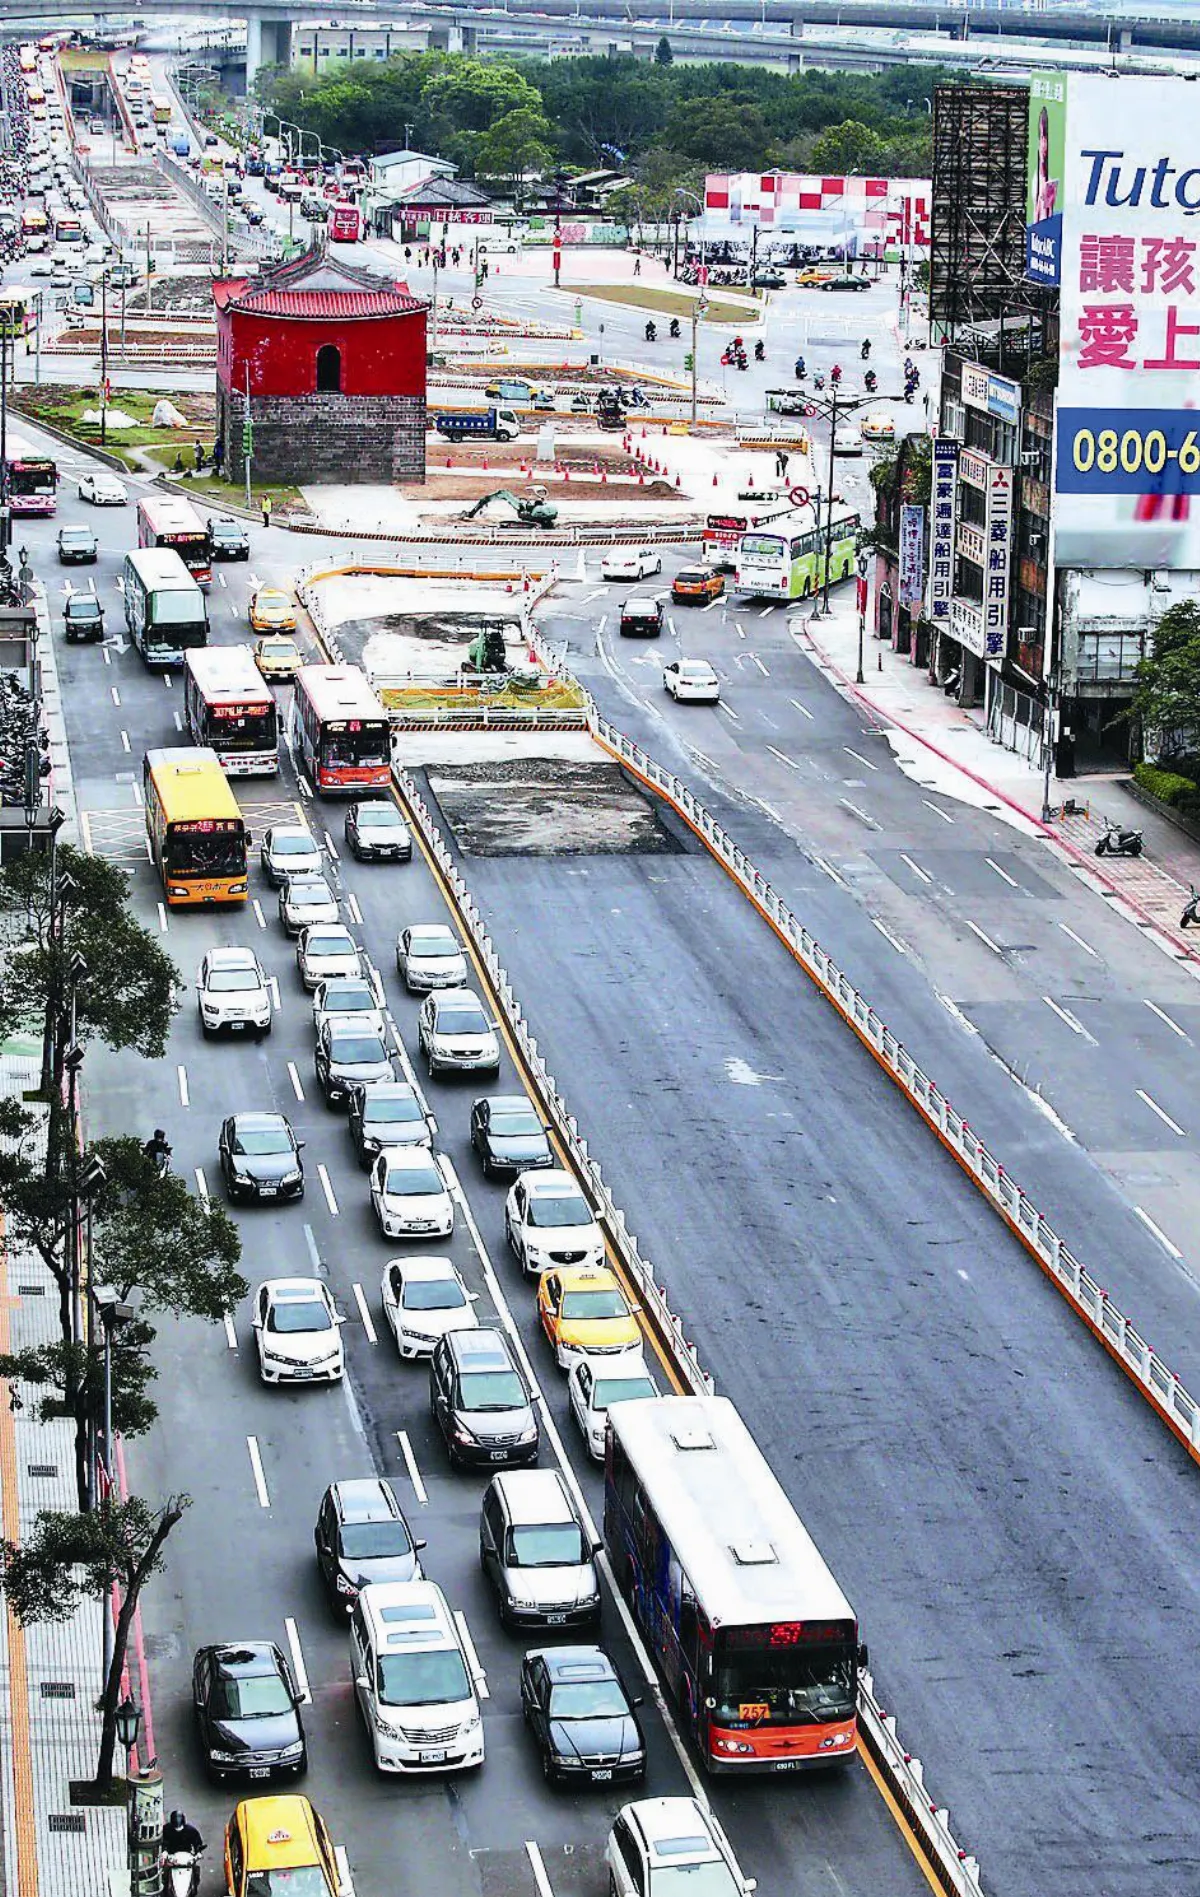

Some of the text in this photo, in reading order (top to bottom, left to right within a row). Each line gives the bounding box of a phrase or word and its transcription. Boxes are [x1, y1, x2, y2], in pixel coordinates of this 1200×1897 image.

[1079, 235, 1197, 295] 讓孩
[1077, 303, 1200, 370] 愛上
[1073, 428, 1200, 474] 0800-6
[986, 493, 1009, 655] 三菱船用引擎
[743, 1706, 766, 1719] 257
